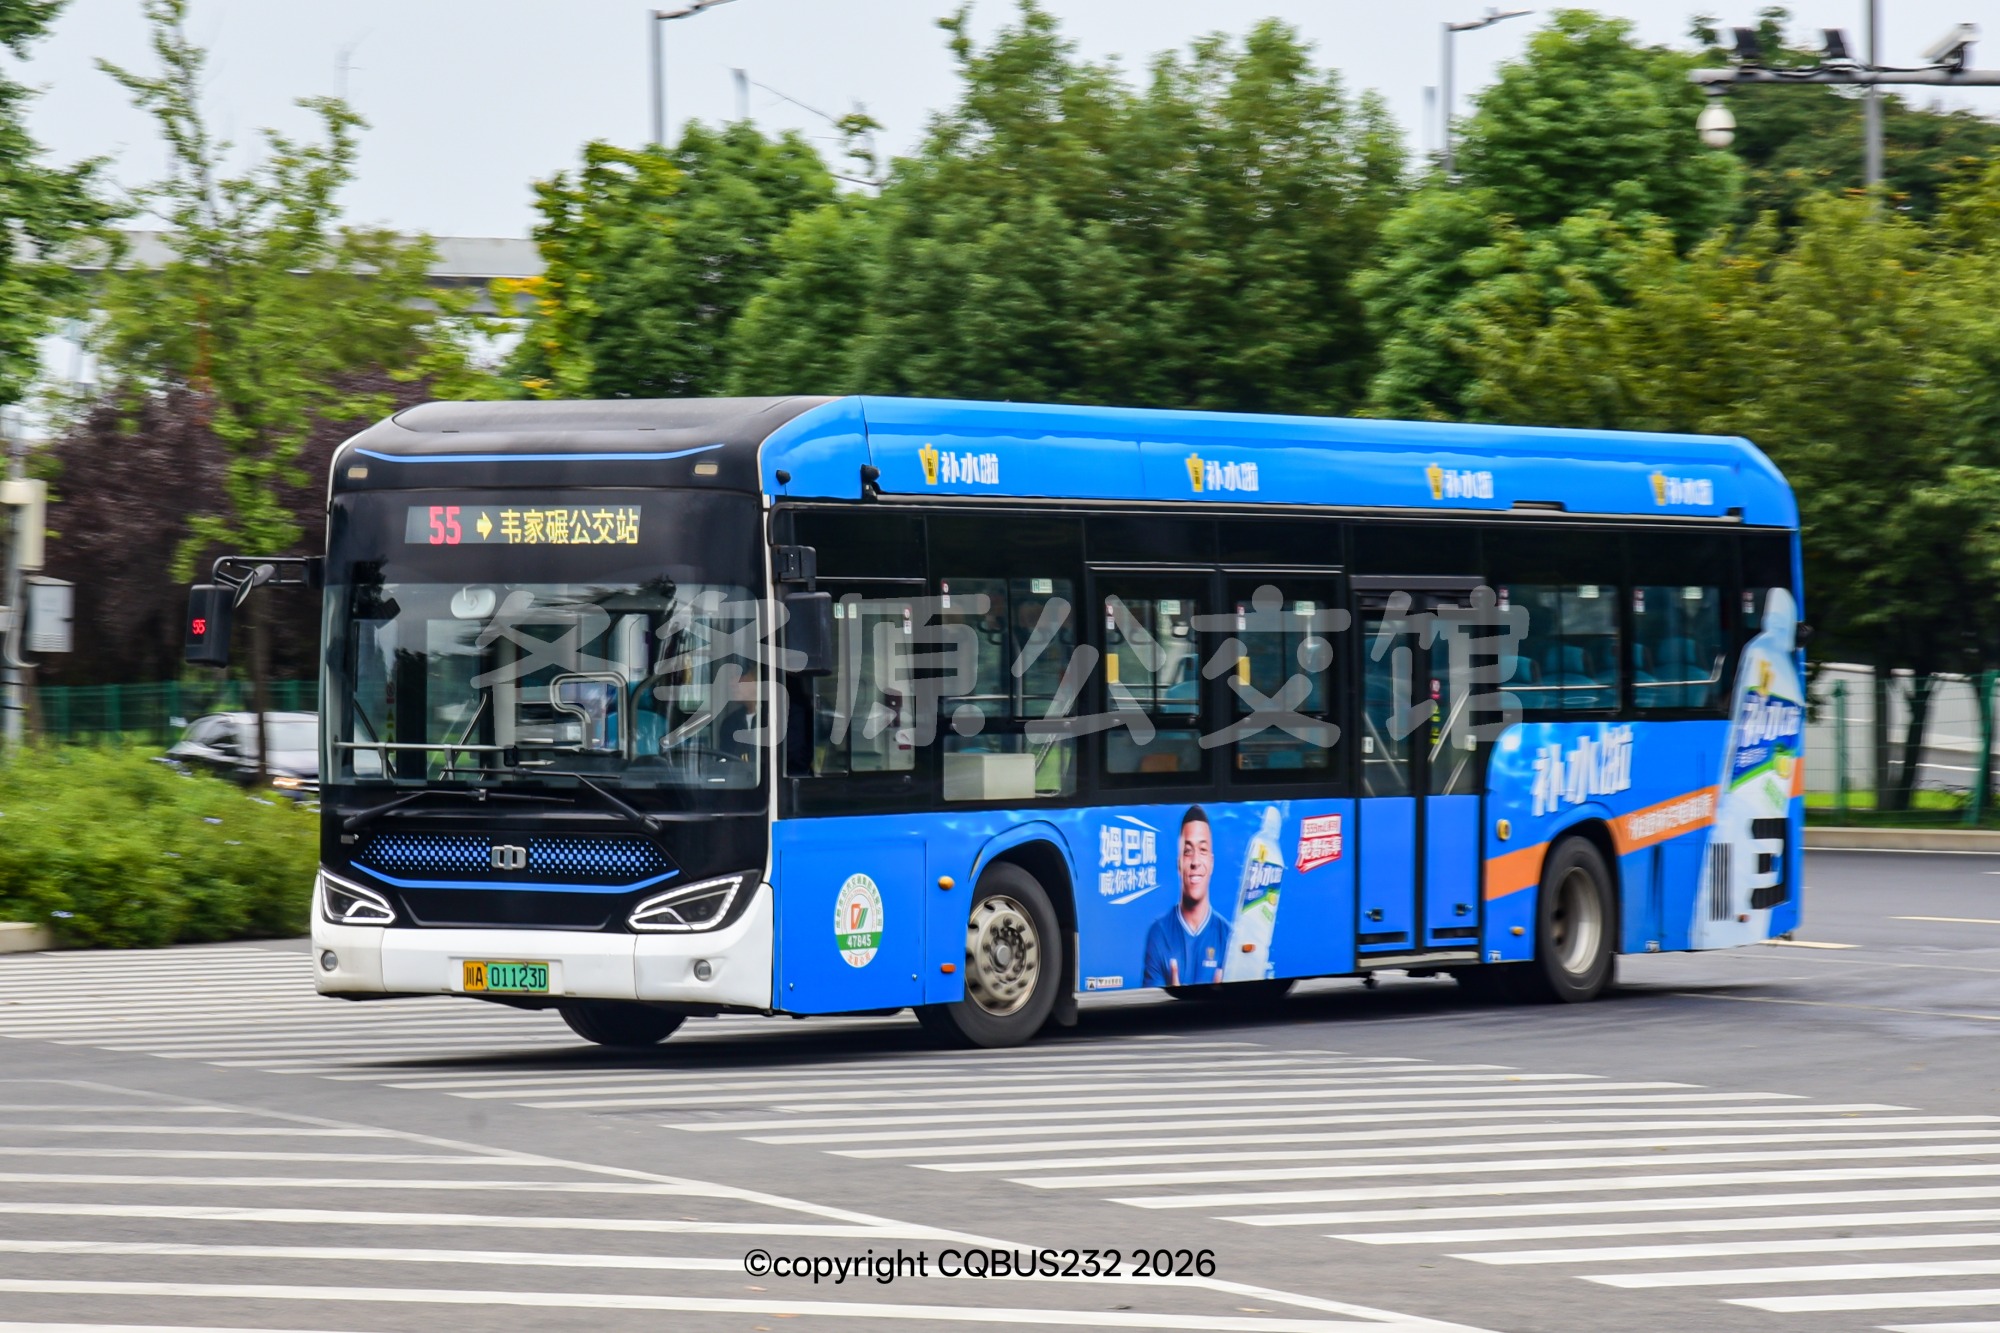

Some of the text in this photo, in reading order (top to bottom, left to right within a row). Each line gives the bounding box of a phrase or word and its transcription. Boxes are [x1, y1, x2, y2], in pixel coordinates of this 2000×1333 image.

[940, 451, 999, 485] 补水啦
[1205, 460, 1259, 492] 补水啦
[429, 505, 639, 545] 55 韦家碾公交站
[191, 618, 207, 635] 55
[1530, 724, 1634, 817] 补水啦
[1098, 824, 1158, 868] 姆巴佩
[1098, 866, 1158, 896] 喊你补水啦
[846, 933, 872, 948] 47845
